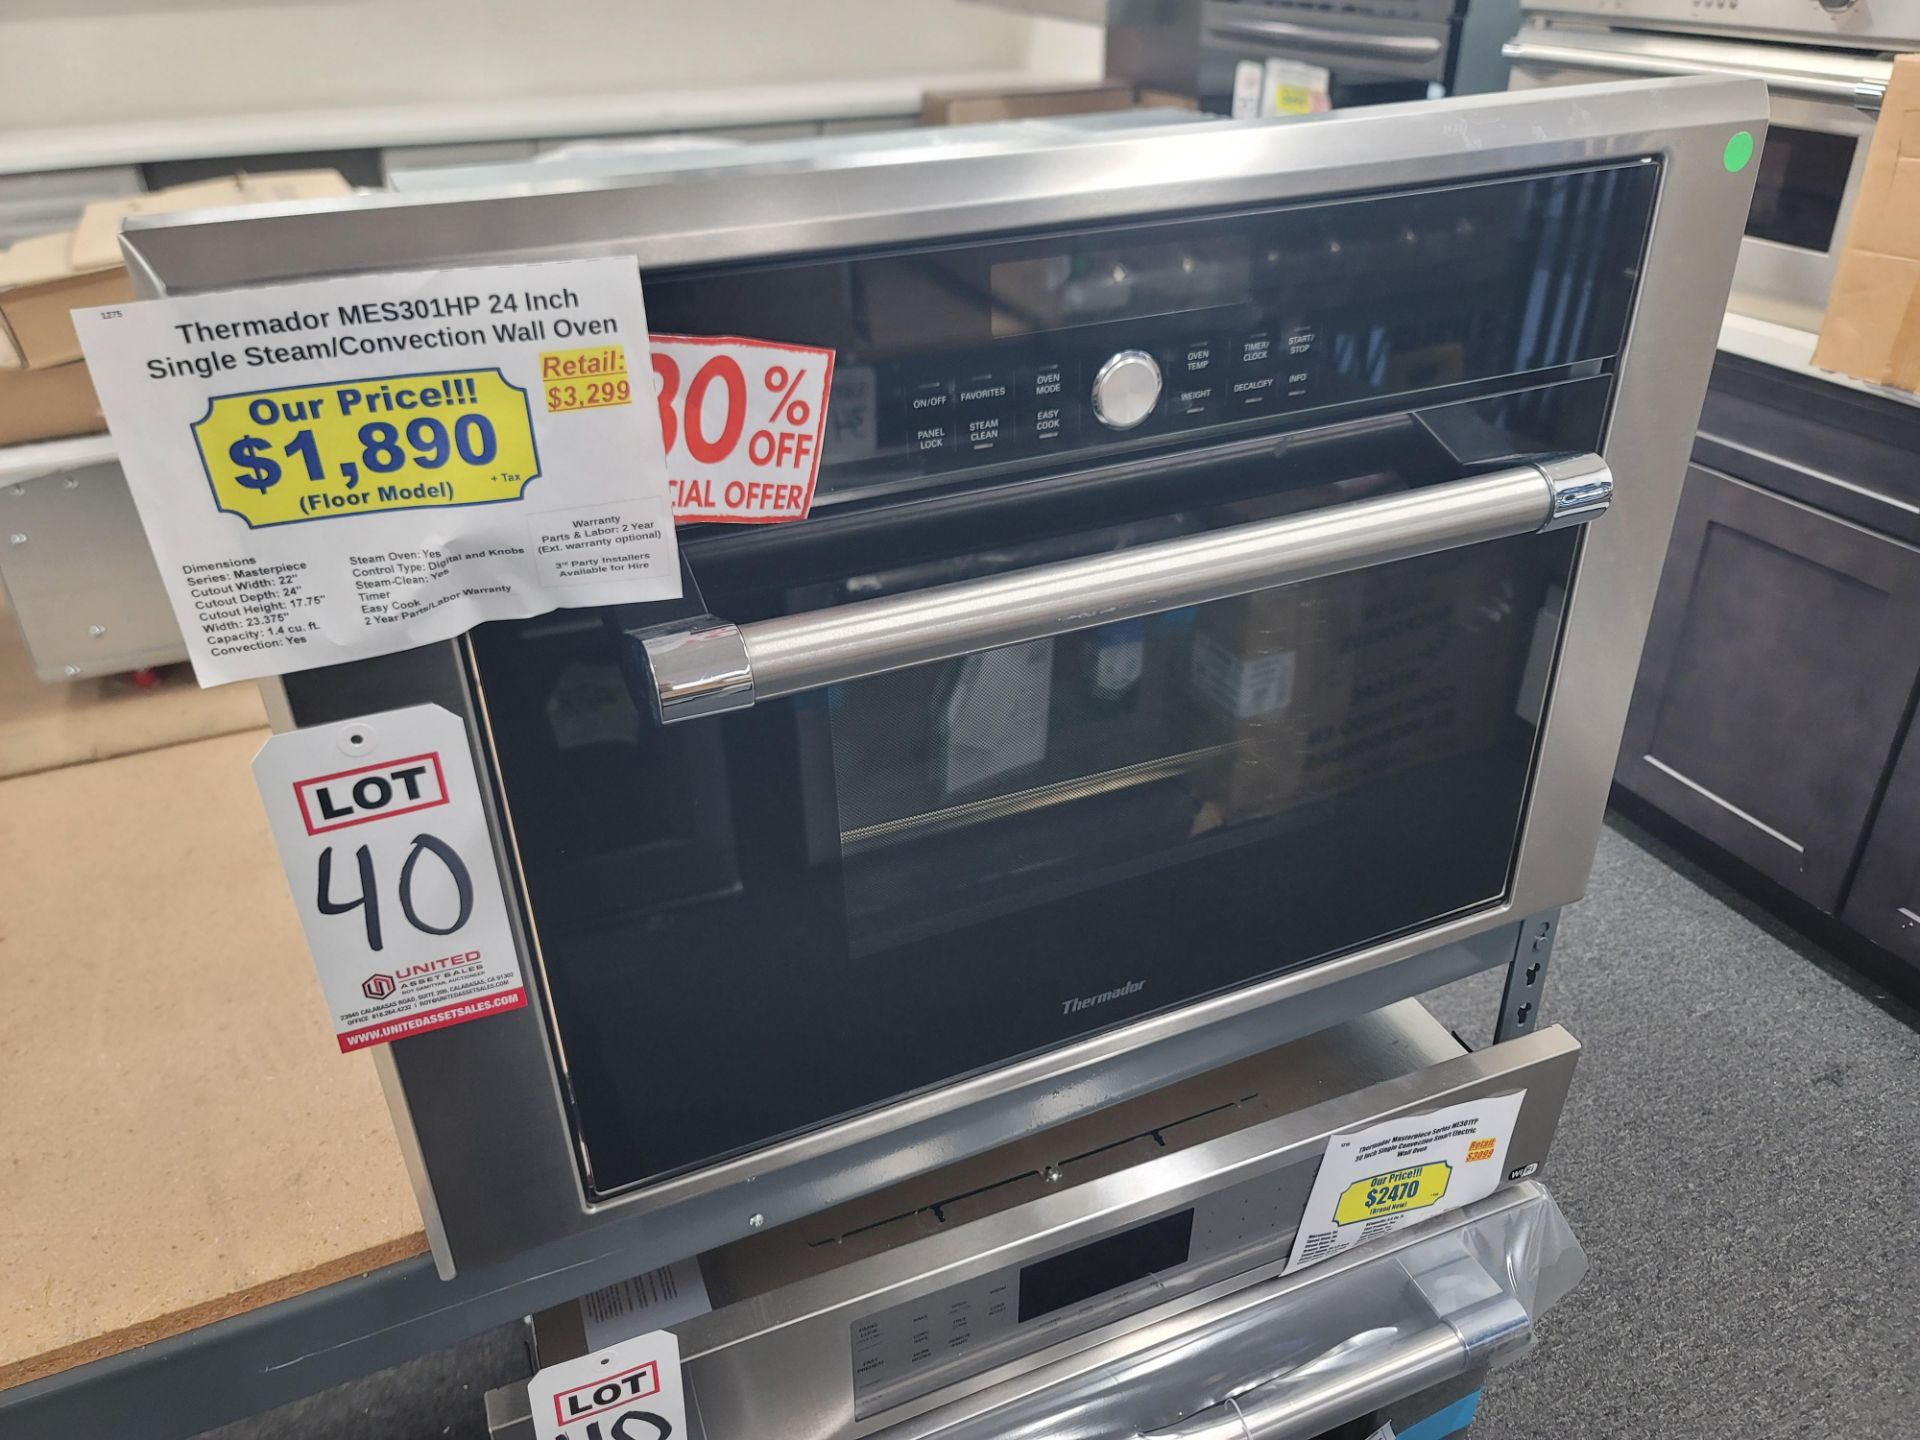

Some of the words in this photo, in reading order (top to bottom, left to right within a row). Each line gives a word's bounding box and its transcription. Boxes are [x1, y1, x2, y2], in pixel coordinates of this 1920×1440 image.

[175, 311, 330, 344] Thermador
[338, 295, 480, 326] MES301HP
[488, 293, 518, 314] 24
[525, 288, 579, 311] Inch
[147, 351, 237, 379] Single
[245, 327, 486, 366] Steam/Convection
[493, 320, 546, 343] Wall
[554, 317, 618, 338] Oven
[1244, 341, 1270, 352] TIMER/
[1288, 334, 1316, 345] START/
[1290, 344, 1310, 355] STOP
[543, 351, 625, 378] Retail:
[1187, 350, 1210, 361] OVEN
[1187, 360, 1209, 371] TEMP
[1243, 351, 1268, 362] CLOCK
[1037, 373, 1061, 384] OVEN
[1233, 378, 1274, 392] DECALCIFY
[1288, 373, 1308, 383] INFO
[548, 380, 630, 410] $3,299
[764, 366, 810, 426] %
[960, 387, 1006, 401] FAVORITES
[1036, 383, 1061, 395] MODE
[1180, 388, 1212, 401] WEIGHT
[249, 398, 324, 425] Our
[337, 378, 478, 416] Price!!!
[913, 395, 947, 409] ON/OFF
[969, 419, 999, 431] STEAM
[1036, 419, 1061, 431] COOK
[1037, 409, 1060, 420] EASY
[917, 428, 945, 439] PANEL
[970, 430, 998, 442] CLEAN
[229, 413, 497, 494] $1,890
[749, 429, 813, 468] OFF
[920, 439, 943, 450] LOCK
[501, 473, 521, 483] Tax
[299, 492, 370, 515] (Floor
[378, 482, 454, 502] Model)
[724, 480, 803, 510] OFFER
[541, 533, 570, 543] Parts
[574, 531, 581, 539] &
[584, 526, 620, 538] Labor:
[622, 524, 629, 532] 2
[631, 521, 654, 530] Year
[572, 516, 621, 529] Warranty
[537, 544, 563, 555] (Ext.
[565, 537, 612, 550] warranty
[615, 530, 662, 546] optional)
[182, 557, 256, 575] Dimensions
[349, 555, 386, 566] Steam
[388, 551, 421, 561] Oven:
[422, 549, 442, 558] Yes
[352, 565, 395, 578] Control
[398, 563, 426, 574] Type:
[429, 554, 462, 571] Digital
[465, 551, 486, 560] and
[488, 547, 525, 556] Knobs
[571, 558, 599, 568] Party
[602, 552, 651, 563] Installers
[187, 574, 232, 586] Series:
[234, 562, 307, 579] Masterpiece
[355, 576, 429, 590] Steam-Clean:
[430, 569, 449, 580] Yes
[559, 566, 608, 577] Available
[628, 562, 649, 570] Hire
[191, 585, 233, 598] Cutout
[235, 578, 276, 591] Width:
[278, 574, 298, 585] 22"
[358, 591, 390, 602] Timer
[195, 596, 238, 610] Cutout
[240, 590, 280, 604] Depth:
[283, 586, 302, 597] 24"
[199, 607, 241, 621] Cutout
[244, 602, 287, 615] Height:
[290, 595, 326, 608] 17.75"
[361, 603, 389, 614] Easy
[392, 600, 421, 610] Cook
[364, 617, 372, 625] 2
[373, 613, 399, 624] Year
[401, 592, 461, 620] Parts/Labor
[462, 584, 512, 596] Warranty
[203, 620, 244, 633] Width:
[246, 613, 289, 627] 23.375"
[207, 629, 265, 645] Capacity:
[267, 627, 285, 636] 1.4
[288, 624, 306, 633] cu.
[308, 621, 321, 631] ft.
[211, 640, 284, 657] Convection:
[286, 636, 307, 645] Yes
[316, 765, 427, 820] LOT
[317, 833, 474, 952] 40
[395, 950, 481, 979] UNITED
[401, 975, 441, 989] ASSET
[444, 964, 483, 978] SALES
[361, 1002, 397, 1015] CALABASAS
[450, 980, 486, 992] CALABASAS,
[1062, 980, 1146, 1014] Thermador
[347, 993, 518, 1046] WWW.UNITEDASSETSALES.COM
[347, 1016, 368, 1025] OFFICE
[1359, 1138, 1391, 1153] Thermador
[1392, 1129, 1432, 1143] Masterpiece
[1432, 1124, 1451, 1135] Series
[1363, 1150, 1378, 1160] Inch
[1378, 1144, 1398, 1155] Single
[1398, 1137, 1433, 1149] Convection
[1434, 1132, 1452, 1142] Smart
[1452, 1127, 1477, 1137] Electric
[1397, 1149, 1412, 1157] Wall
[1412, 1146, 1428, 1154] Oven
[1371, 1176, 1388, 1187] Our
[1389, 1167, 1423, 1183] Price!!!
[1365, 1180, 1420, 1208] $2470
[568, 1371, 647, 1415] LOT
